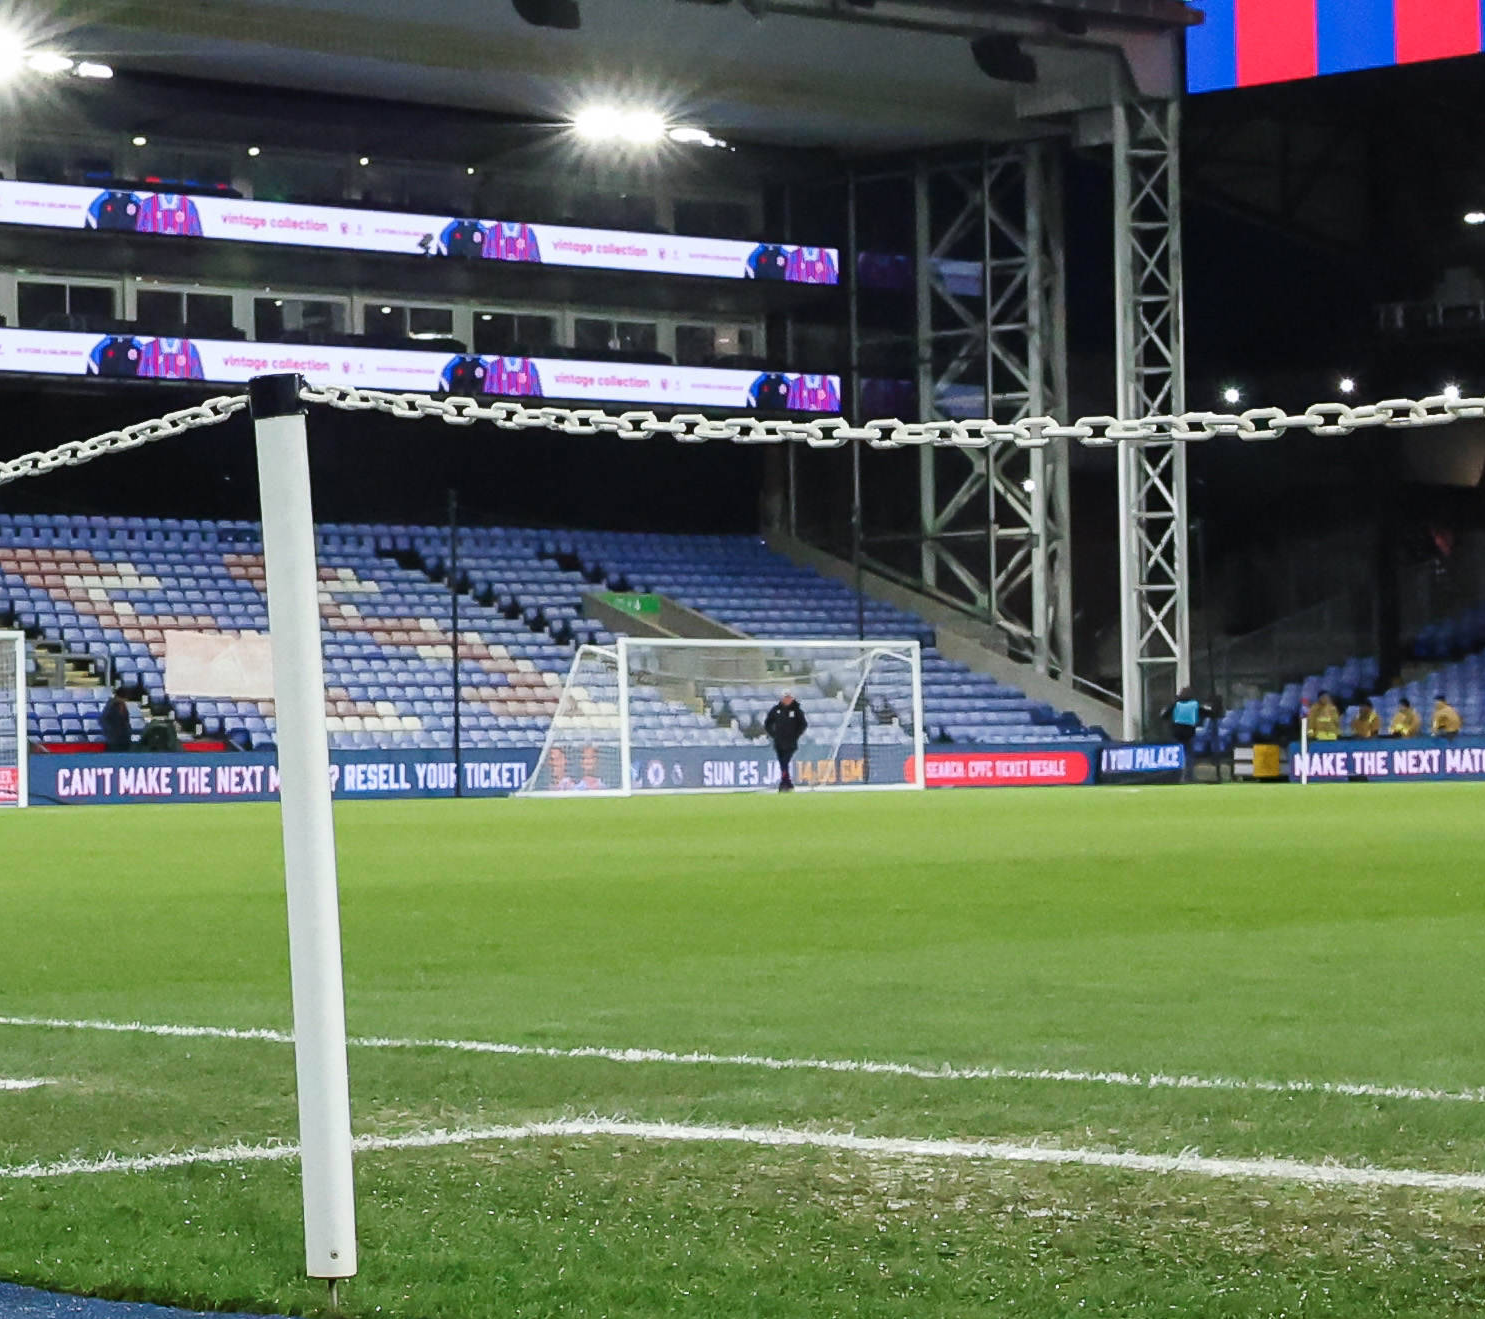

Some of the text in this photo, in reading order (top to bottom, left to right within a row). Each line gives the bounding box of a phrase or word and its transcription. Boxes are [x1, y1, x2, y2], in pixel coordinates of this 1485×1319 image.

[703, 761, 735, 785] SUN
[738, 761, 759, 785] 25
[1352, 751, 1389, 776] THE
[1393, 749, 1441, 775] NEXT
[56, 767, 113, 796] CAN'T
[118, 767, 172, 796] MAKE
[176, 766, 211, 795] THE
[216, 765, 264, 794] NEXT
[343, 763, 412, 791] RESELL
